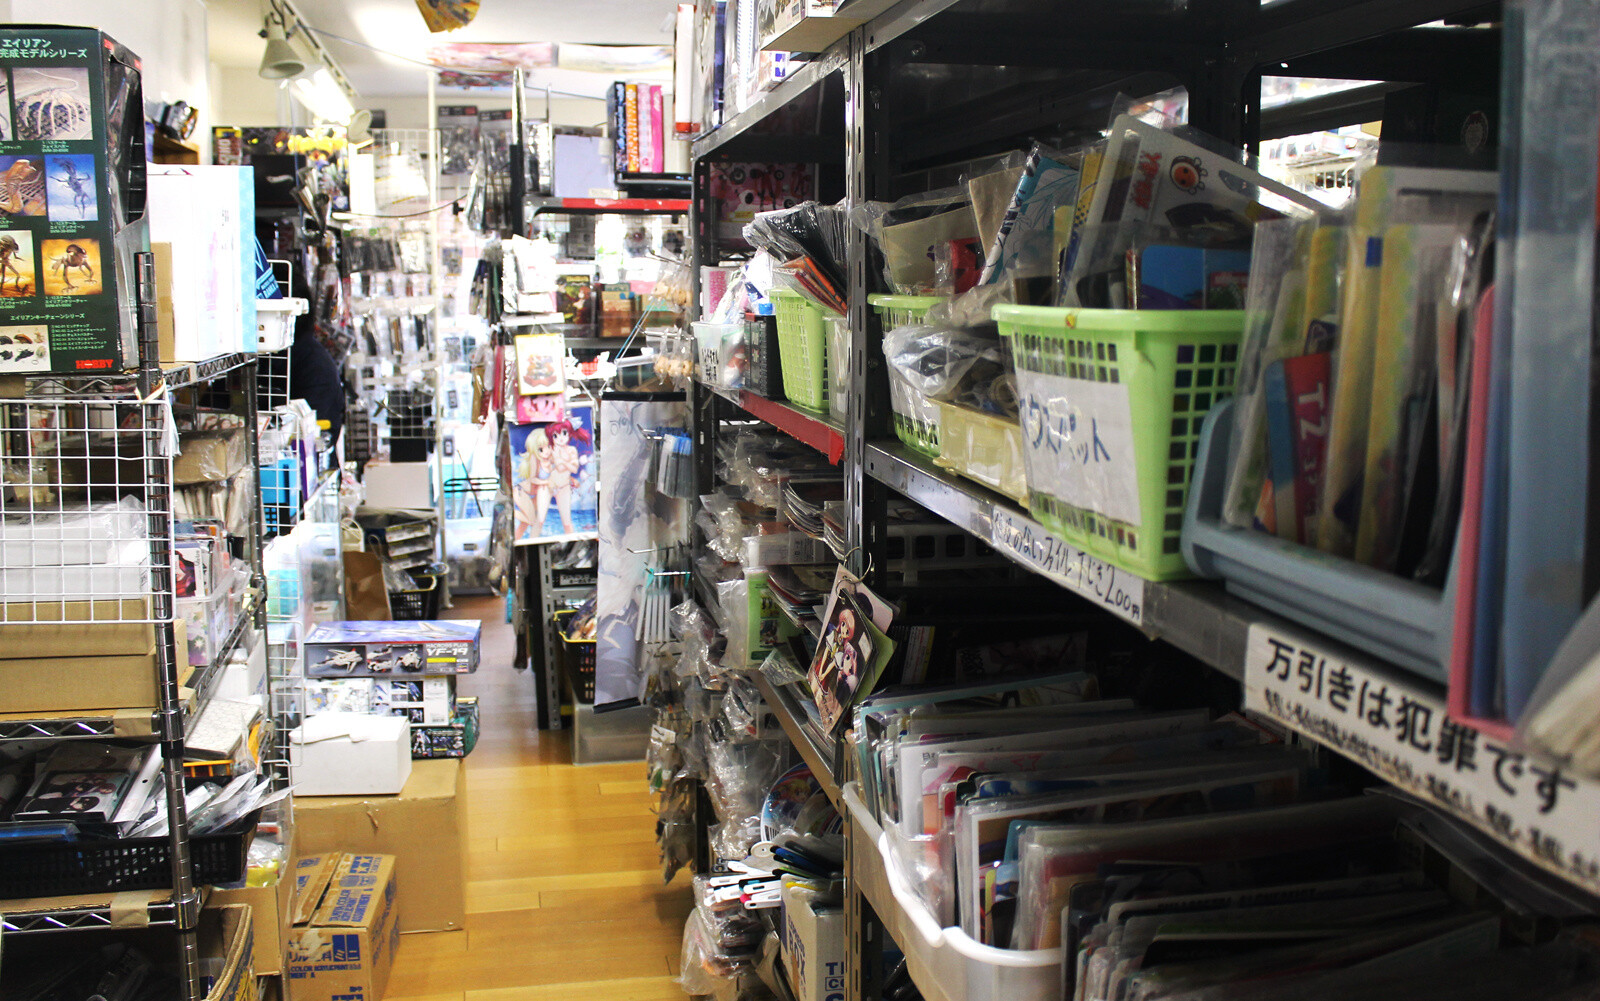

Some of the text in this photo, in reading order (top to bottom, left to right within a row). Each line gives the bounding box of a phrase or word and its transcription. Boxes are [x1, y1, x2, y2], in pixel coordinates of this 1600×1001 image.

[2, 38, 52, 49] エイリアン
[0, 48, 88, 59] 完成モデルシリーズ
[75, 359, 114, 369] HOBBY
[426, 648, 469, 656] YF-19
[1265, 637, 1577, 813] 万引きは犯罪です
